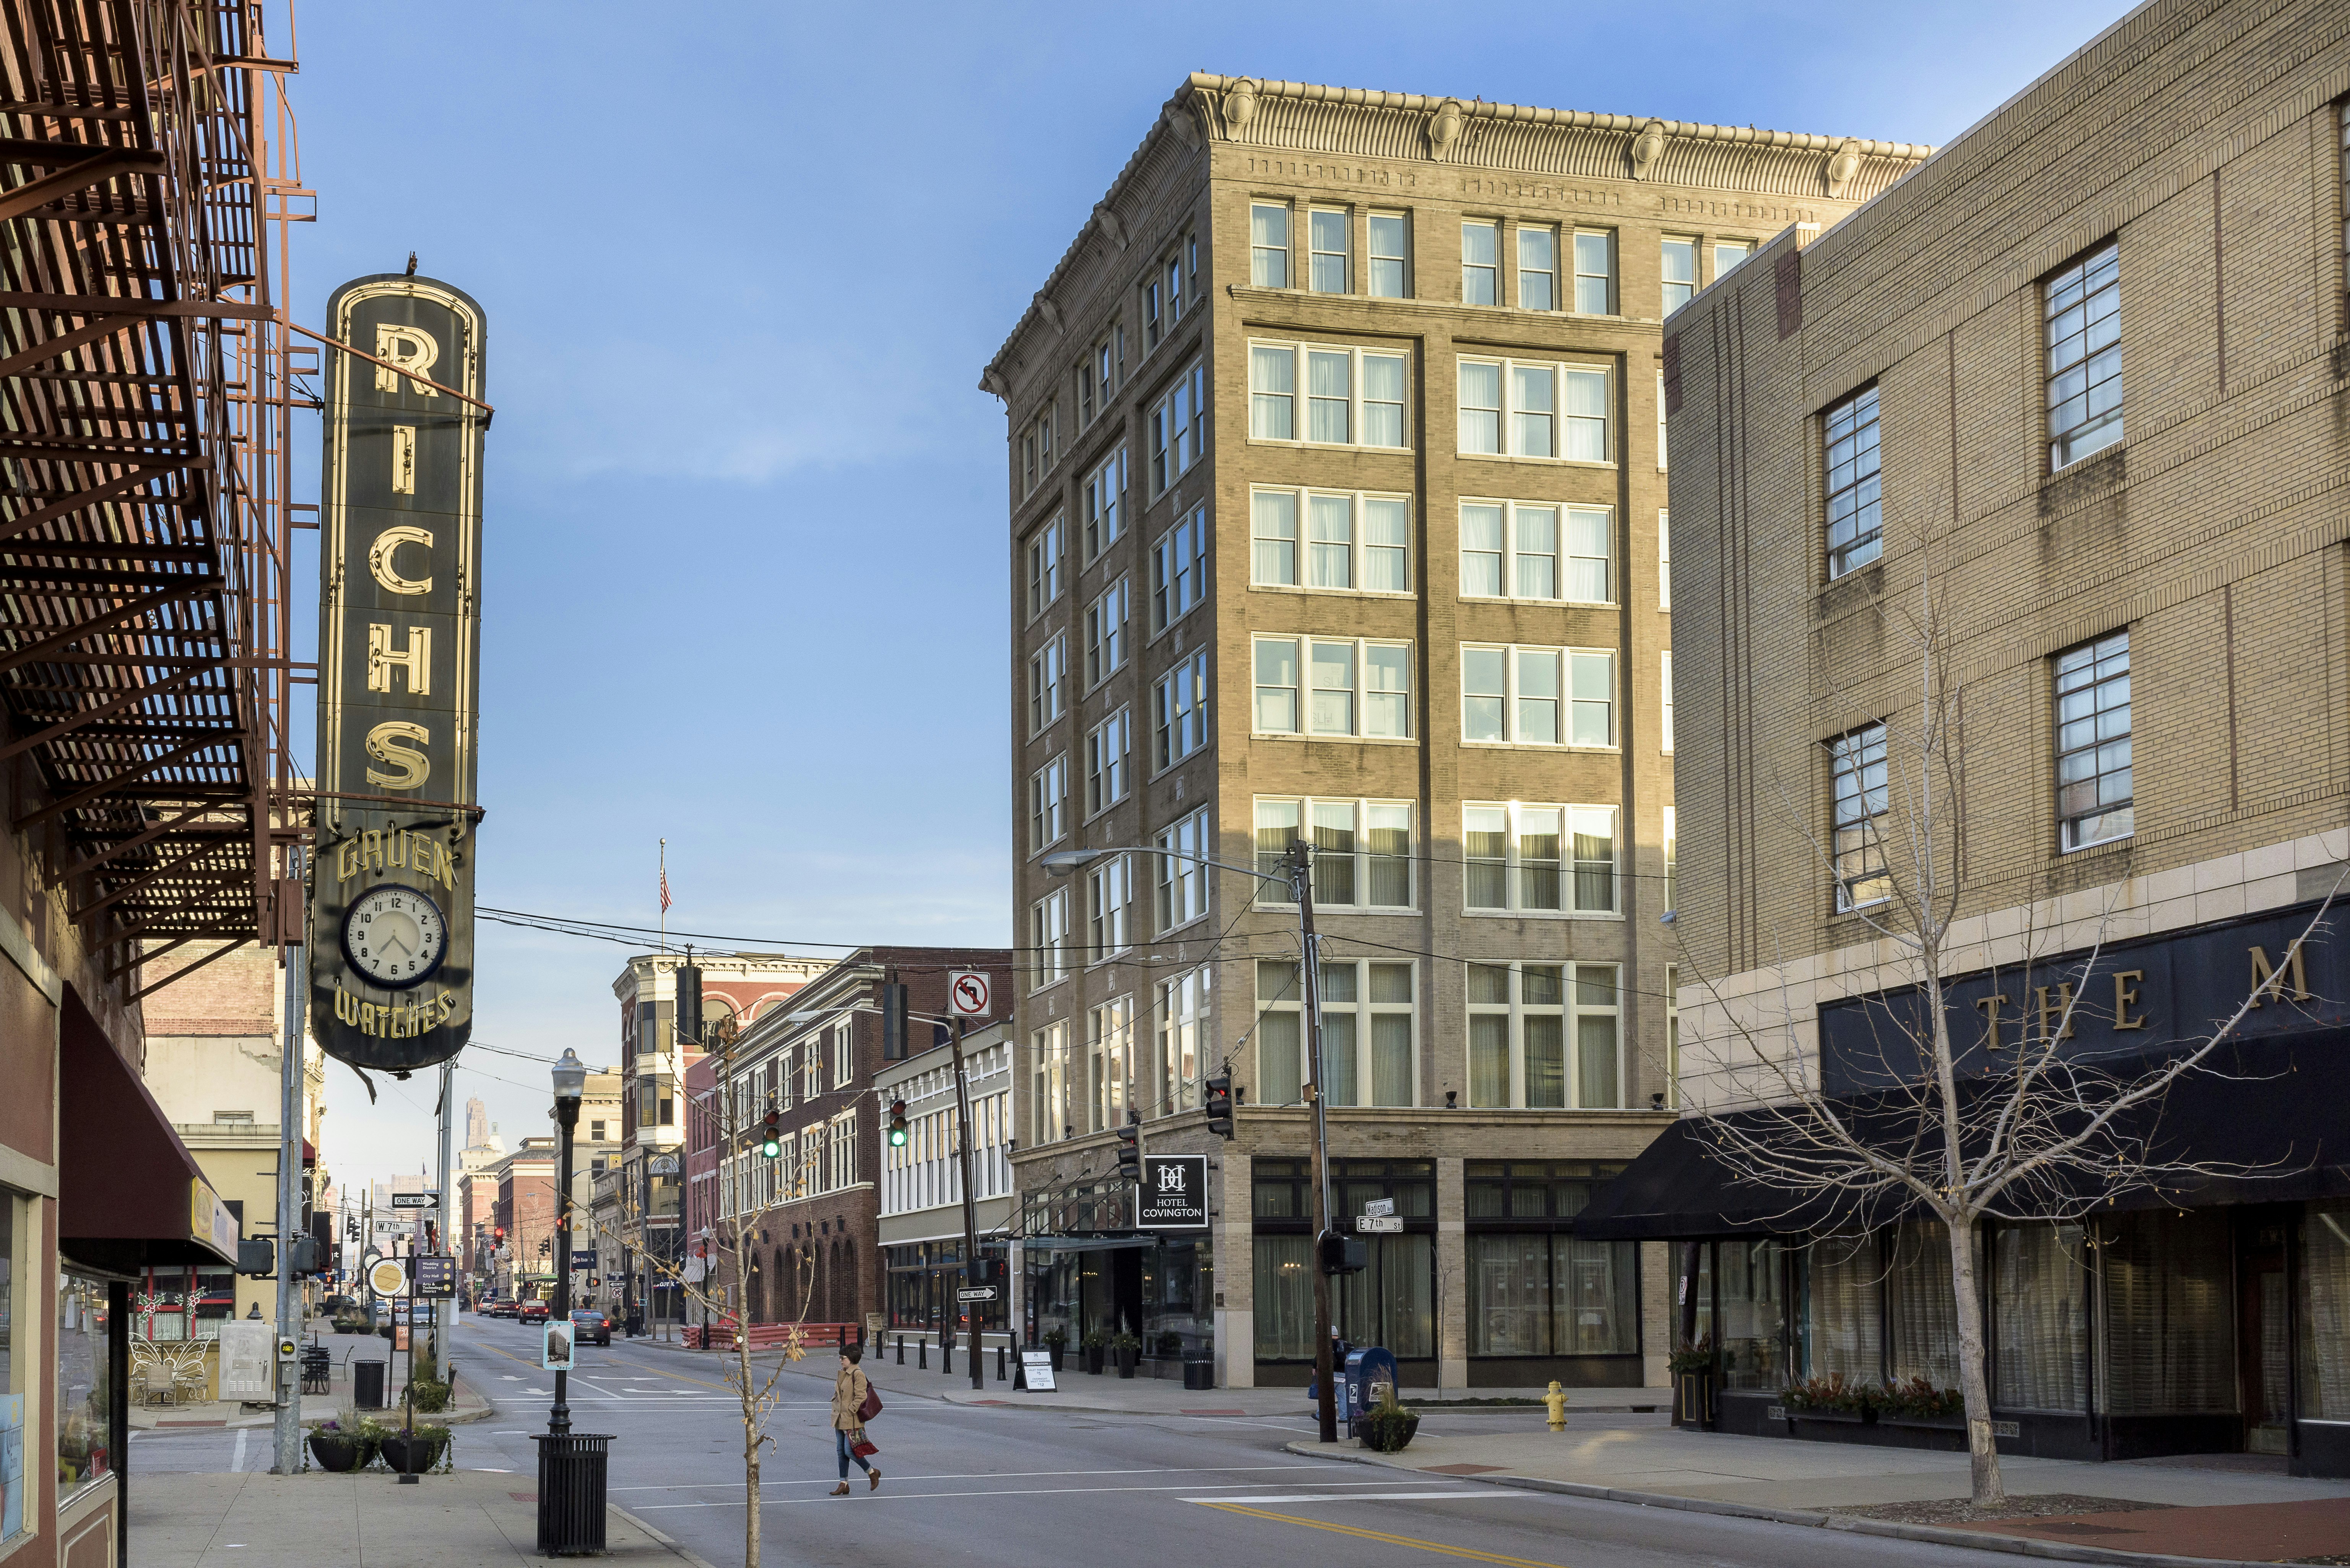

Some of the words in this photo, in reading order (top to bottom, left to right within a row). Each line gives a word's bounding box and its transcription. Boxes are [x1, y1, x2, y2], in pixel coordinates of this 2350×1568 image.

[366, 323, 439, 790] RICHS
[338, 829, 455, 891] GRUEN
[375, 902, 382, 912] 11
[391, 898, 401, 908] 12
[412, 903, 415, 912] 1
[361, 914, 371, 923] 10
[421, 915, 427, 924] 2
[358, 931, 364, 940] 9
[425, 933, 432, 943] 3
[361, 948, 368, 957] 8
[421, 950, 429, 959] 4
[372, 959, 380, 969] 7
[409, 961, 415, 971] 5
[391, 965, 398, 975] 6
[335, 986, 450, 1038] WATCHES
[1976, 969, 2145, 1050] THE
[1143, 1208, 1201, 1217] COVINGTON
[1367, 1203, 1386, 1215] Madison
[378, 1222, 385, 1231] W
[387, 1223, 400, 1231] 7th
[1360, 1219, 1365, 1230] E
[1369, 1219, 1383, 1230] 7th
